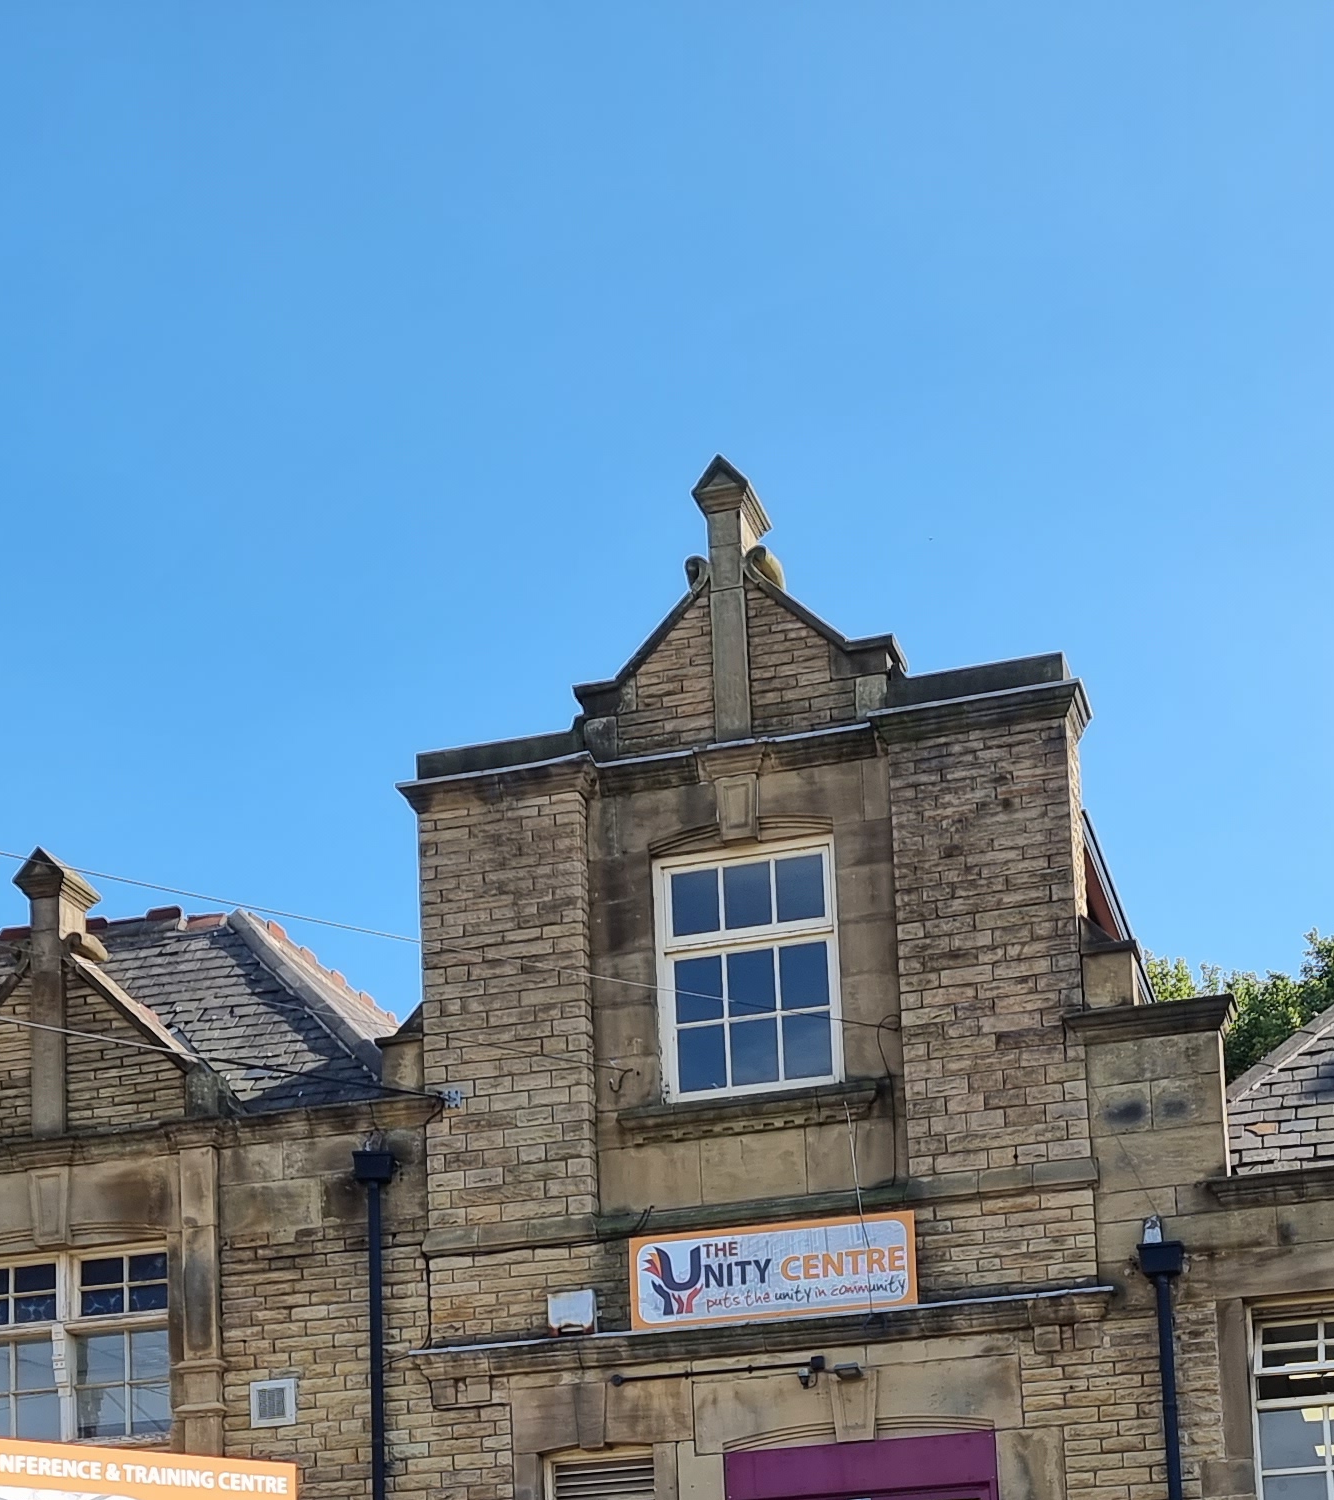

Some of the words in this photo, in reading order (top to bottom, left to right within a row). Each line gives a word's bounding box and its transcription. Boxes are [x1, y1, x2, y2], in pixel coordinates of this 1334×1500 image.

[702, 1241, 738, 1258] THE
[653, 1245, 771, 1291] UNITY
[780, 1246, 905, 1281] CENTRE
[707, 1293, 740, 1312] puts
[744, 1290, 770, 1306] the
[774, 1285, 811, 1303] unity
[815, 1287, 827, 1298] in
[830, 1275, 905, 1297] community
[105, 1463, 121, 1482] &
[122, 1463, 214, 1489] TRAINING
[217, 1472, 288, 1494] CENTRE
